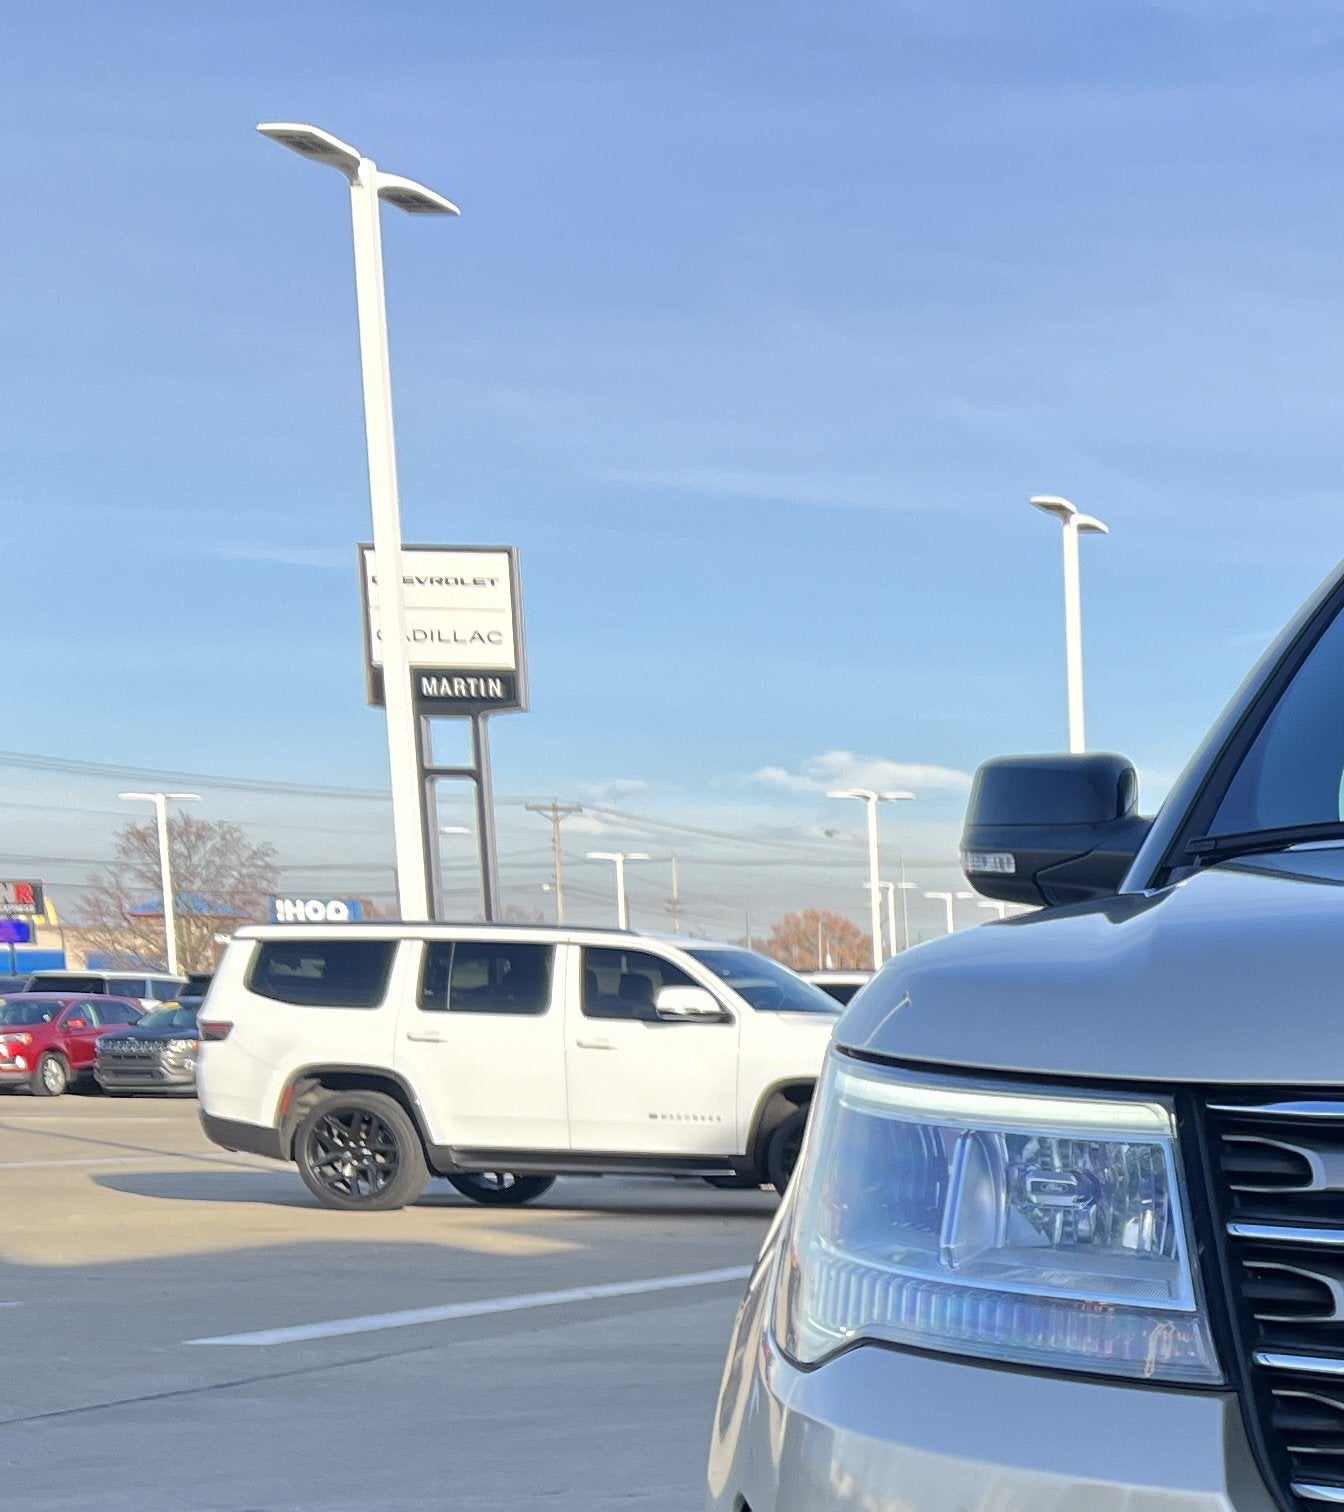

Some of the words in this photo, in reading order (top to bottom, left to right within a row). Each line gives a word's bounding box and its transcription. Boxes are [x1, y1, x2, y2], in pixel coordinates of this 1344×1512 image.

[370, 574, 499, 587] EVROLET
[376, 628, 504, 645] DILLAC
[421, 676, 504, 699] MARTIN
